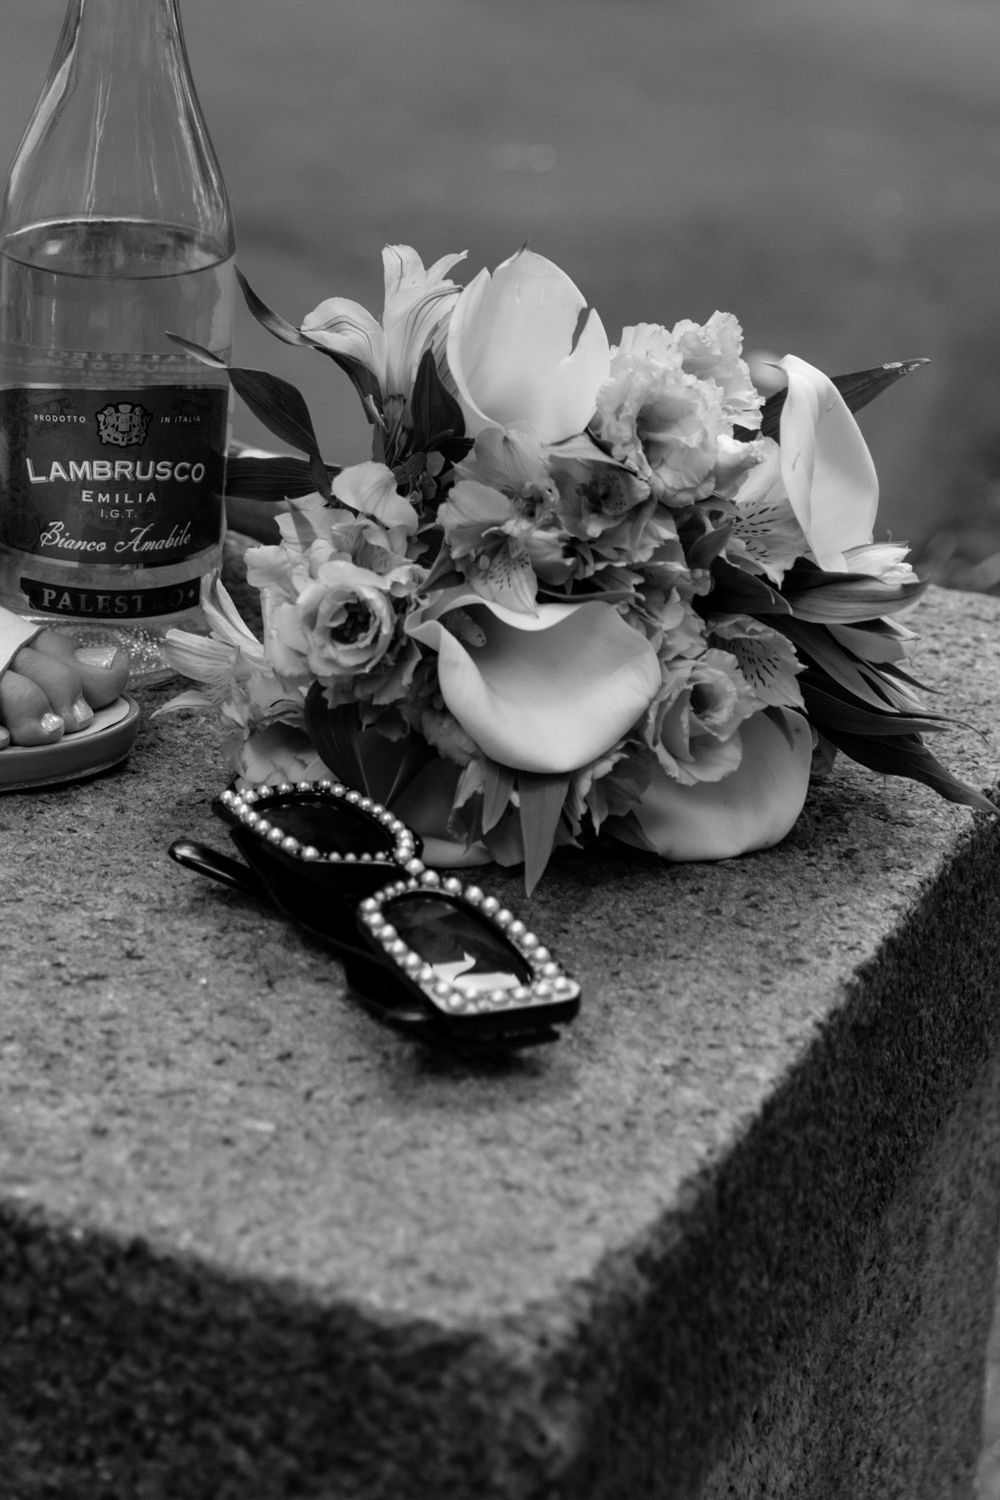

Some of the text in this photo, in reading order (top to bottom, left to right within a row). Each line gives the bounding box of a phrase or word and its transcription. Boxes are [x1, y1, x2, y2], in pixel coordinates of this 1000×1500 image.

[33, 414, 86, 423] PRODOTTO
[174, 415, 201, 423] ITALIA
[25, 457, 206, 484] LAMBRUSCO
[81, 489, 157, 504] EMILIA
[100, 508, 138, 518] I.G.T.
[40, 521, 192, 552] Bianco Amabile
